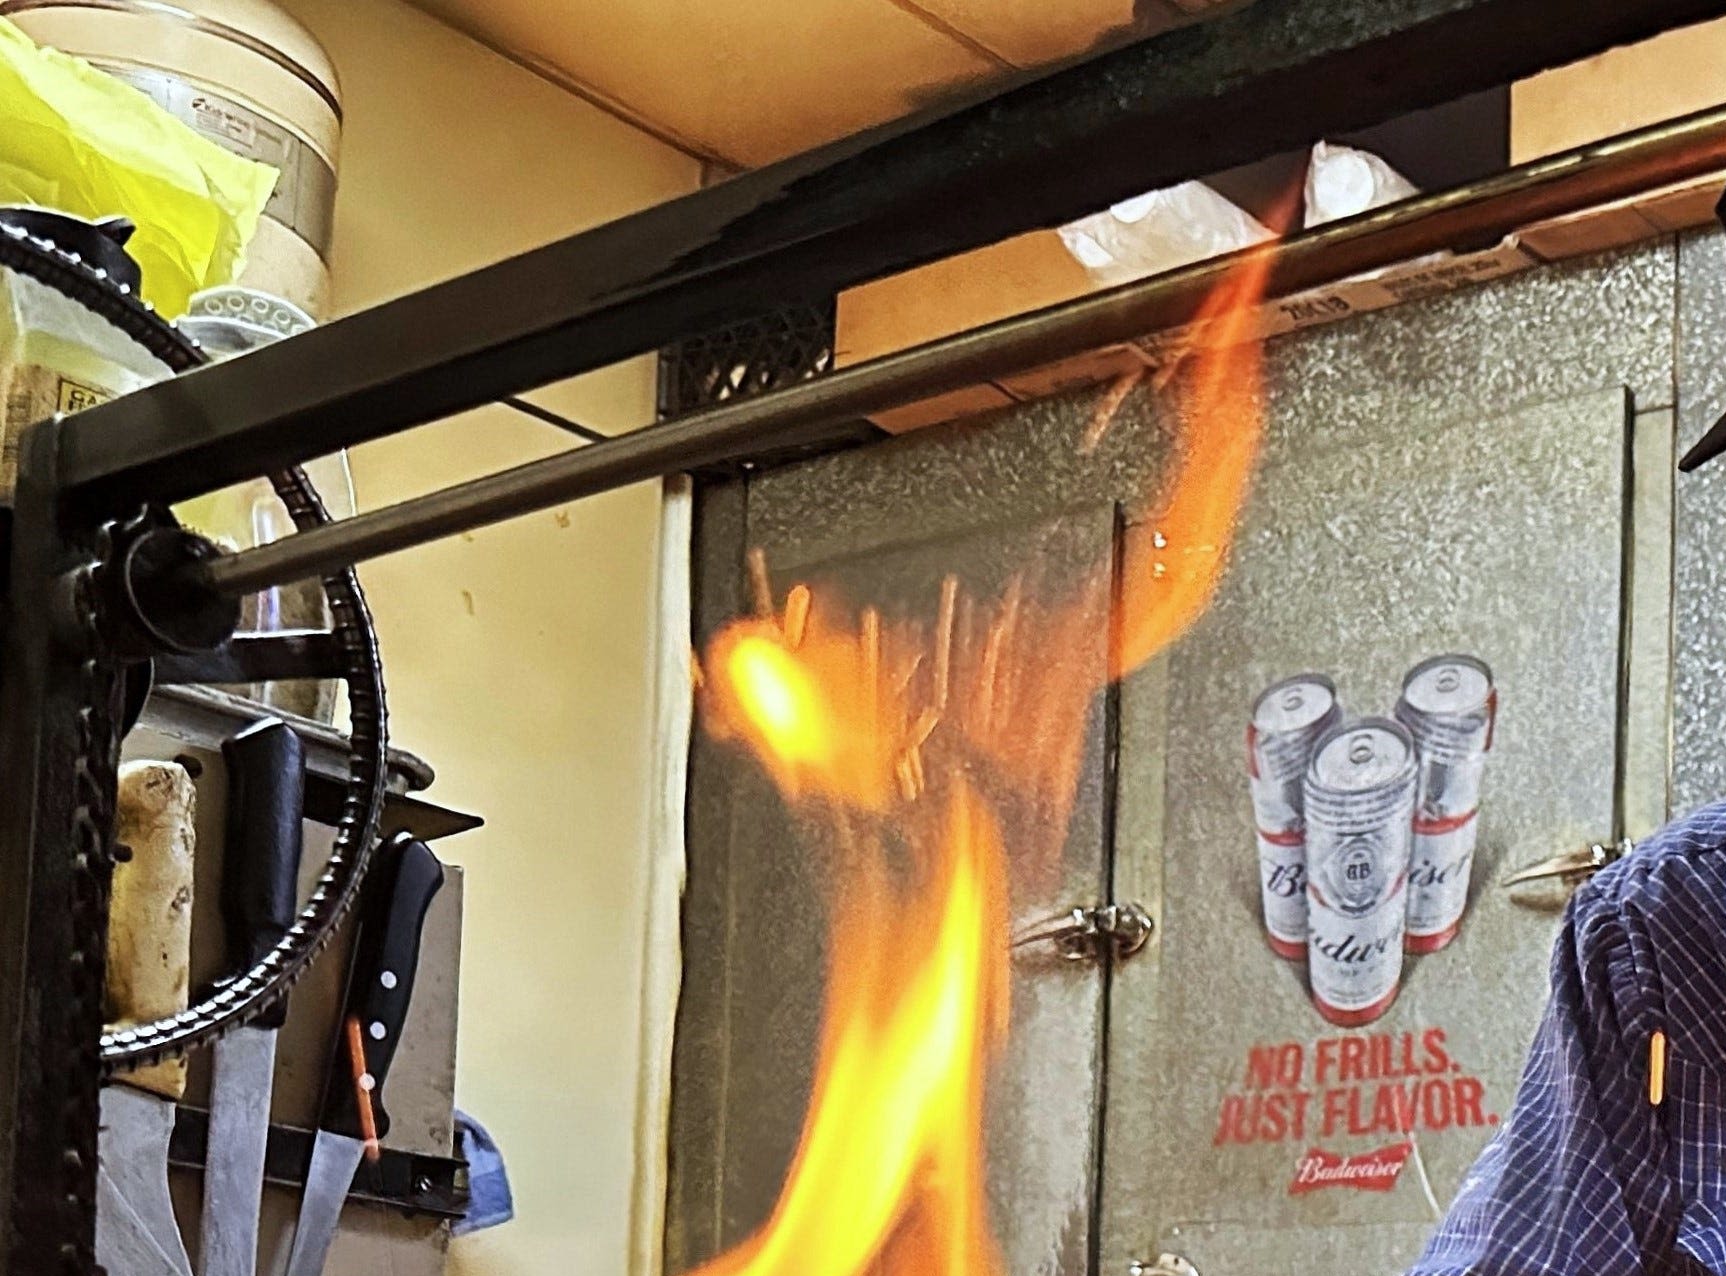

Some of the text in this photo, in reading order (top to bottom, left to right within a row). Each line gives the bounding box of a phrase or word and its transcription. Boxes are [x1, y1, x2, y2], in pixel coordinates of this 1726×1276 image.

[1245, 1027, 1461, 1089] NO FRILLS.
[1213, 1076, 1501, 1147] JUST FLAVOR.
[1297, 1154, 1404, 1184] Budweiser
